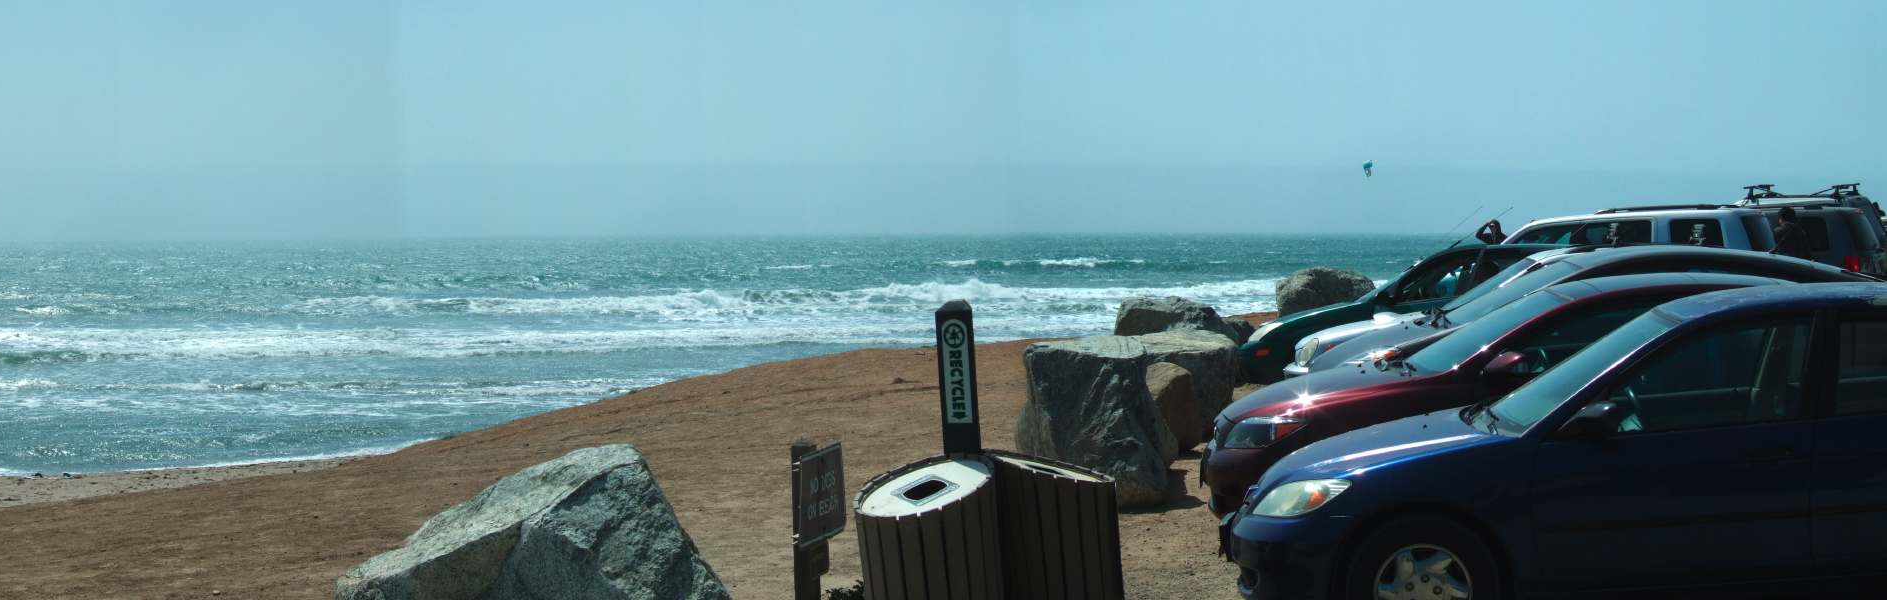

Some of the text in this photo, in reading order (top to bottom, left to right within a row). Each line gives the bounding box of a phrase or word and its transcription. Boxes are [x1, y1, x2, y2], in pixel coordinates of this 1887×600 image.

[949, 350, 966, 411] RECYCLE
[809, 470, 836, 496] NO DOGS
[807, 493, 839, 521] ON BEACH
